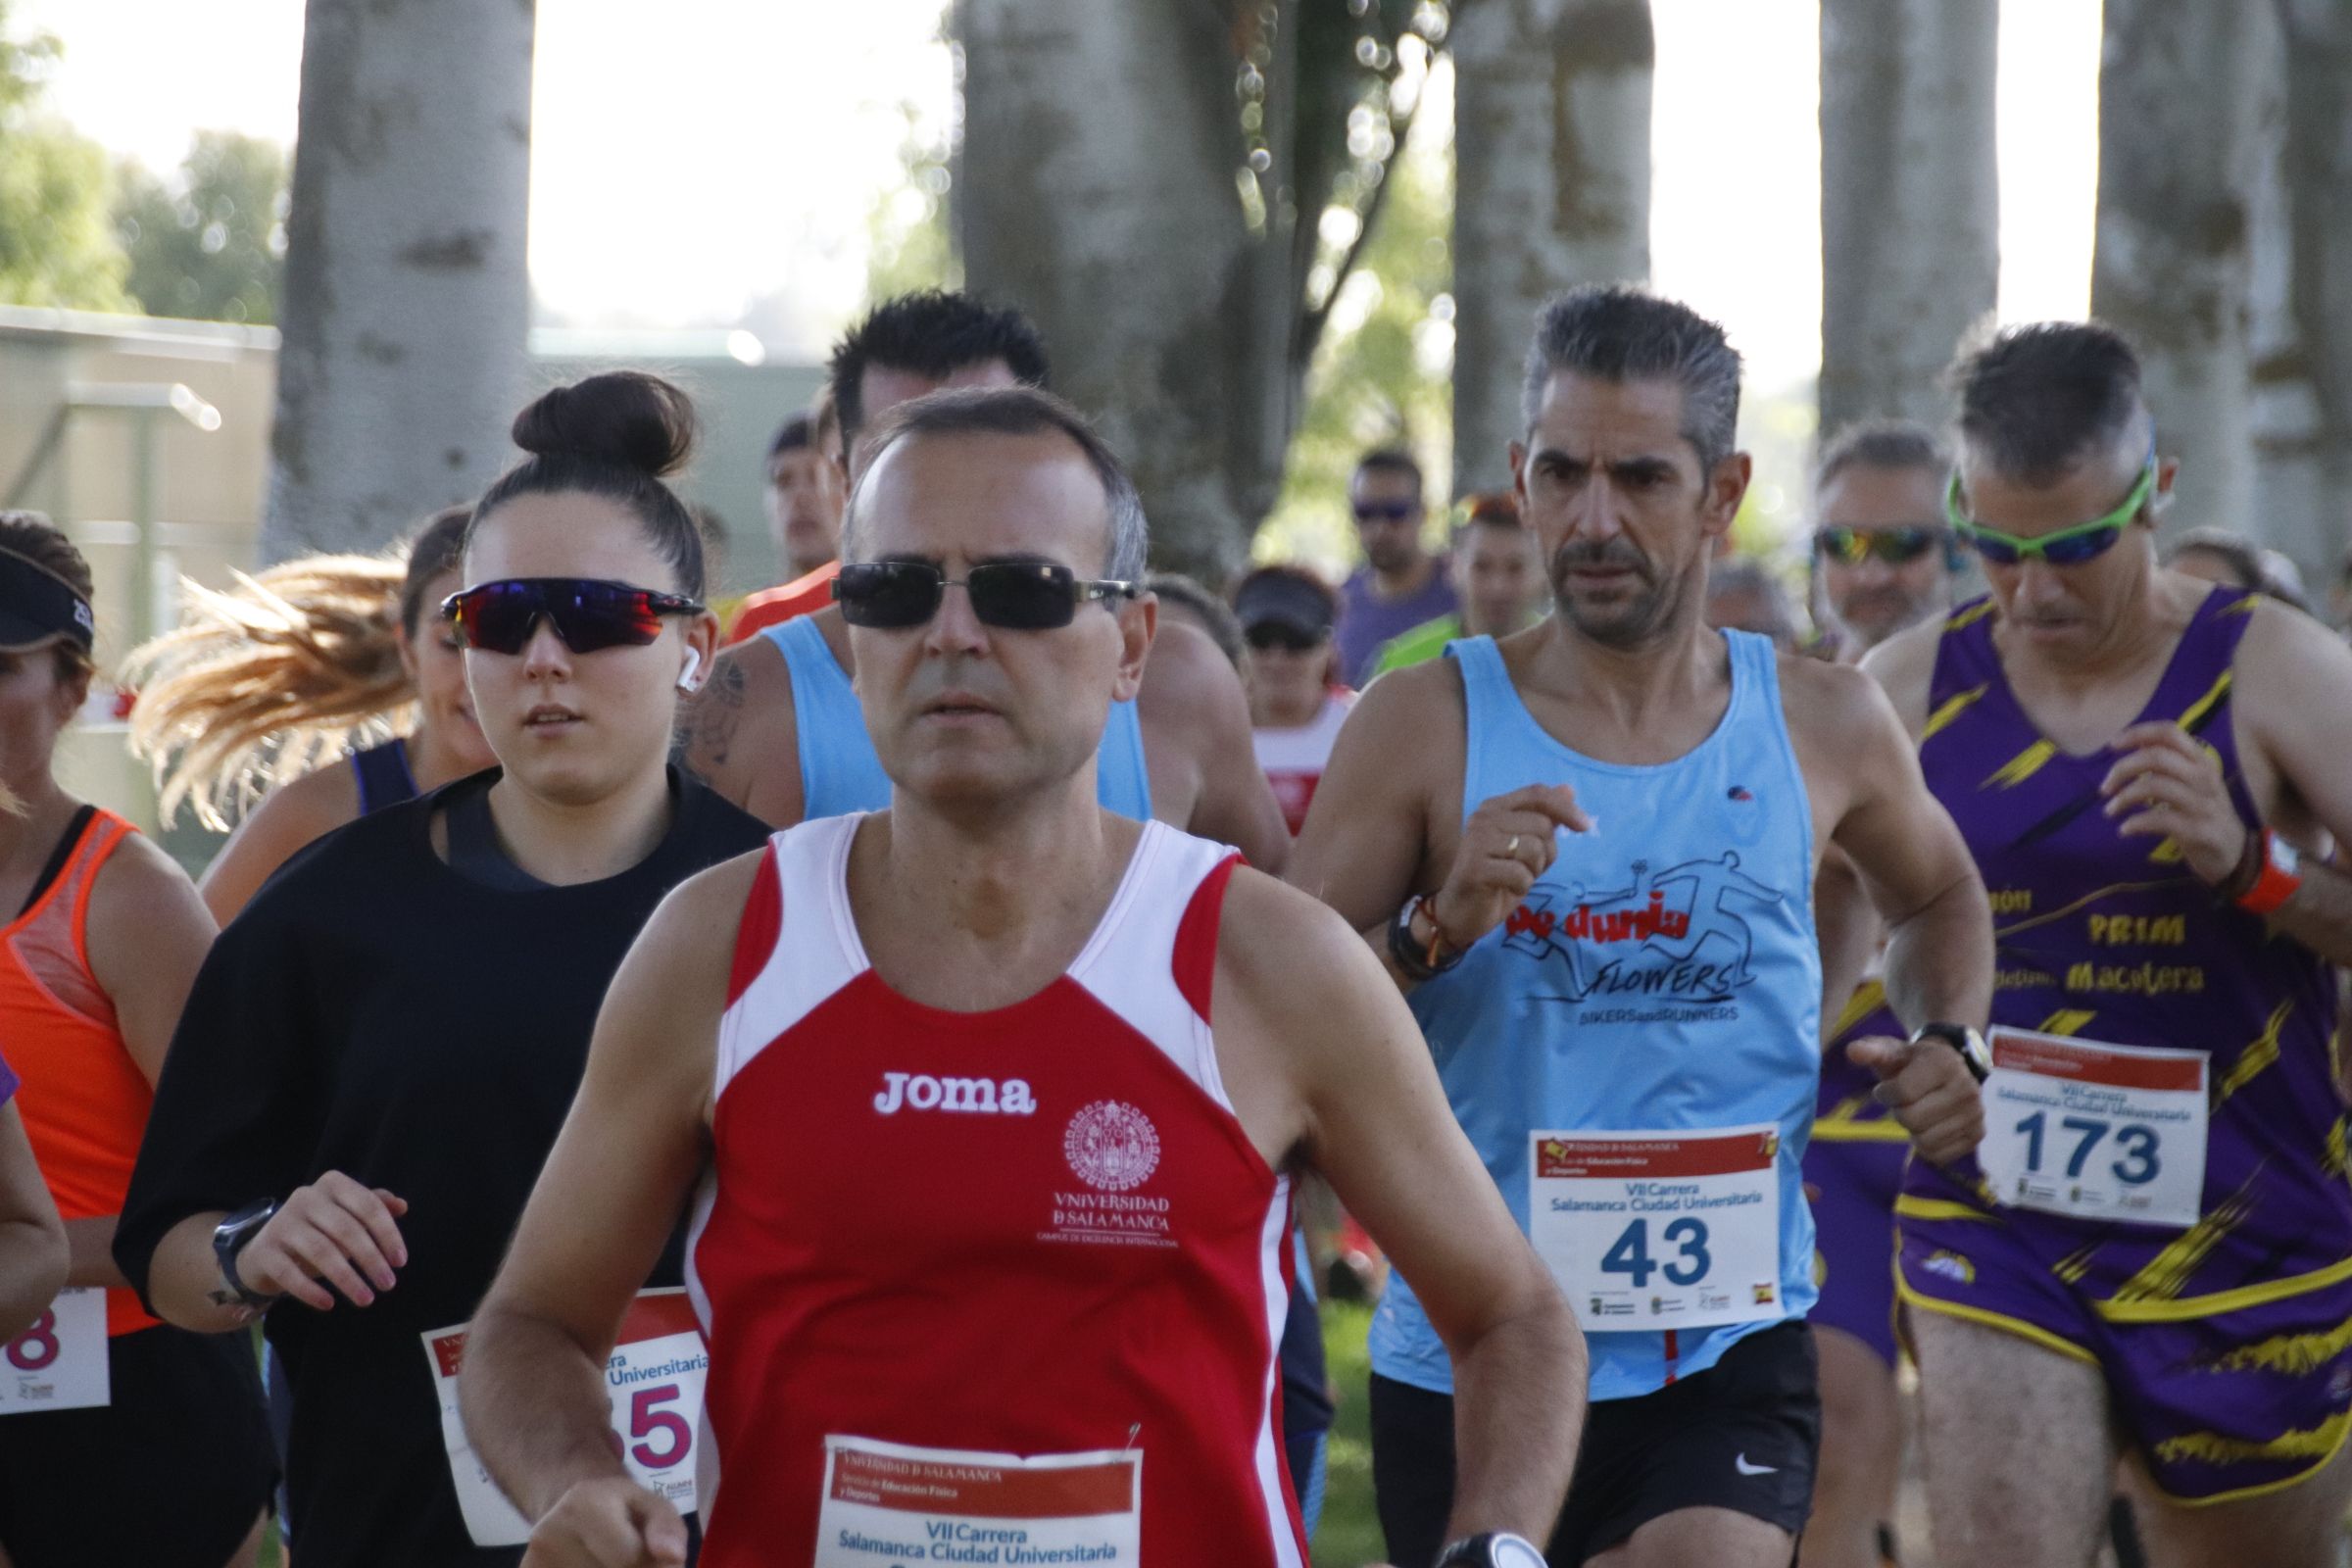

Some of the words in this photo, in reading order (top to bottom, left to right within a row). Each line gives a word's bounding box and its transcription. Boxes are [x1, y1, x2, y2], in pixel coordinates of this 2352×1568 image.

[1589, 959, 1735, 996] FLOWERS
[2016, 1111, 2162, 1185] 173
[1551, 1198, 1627, 1211] Salamanca
[1631, 1198, 1680, 1211] Ciudad
[1685, 1190, 1763, 1209] Universitaria
[1648, 1182, 1699, 1196] Carrera
[1067, 1211, 1169, 1231] SALAMANCA
[1601, 1217, 1711, 1288] 43
[608, 1383, 692, 1469] 5
[881, 1480, 927, 1494] Educación
[926, 1521, 954, 1539] VII
[956, 1523, 1027, 1544] Carrera
[839, 1530, 925, 1559] Salamanca
[930, 1541, 999, 1563] Ciudad
[1004, 1543, 1116, 1564] Universitaria
